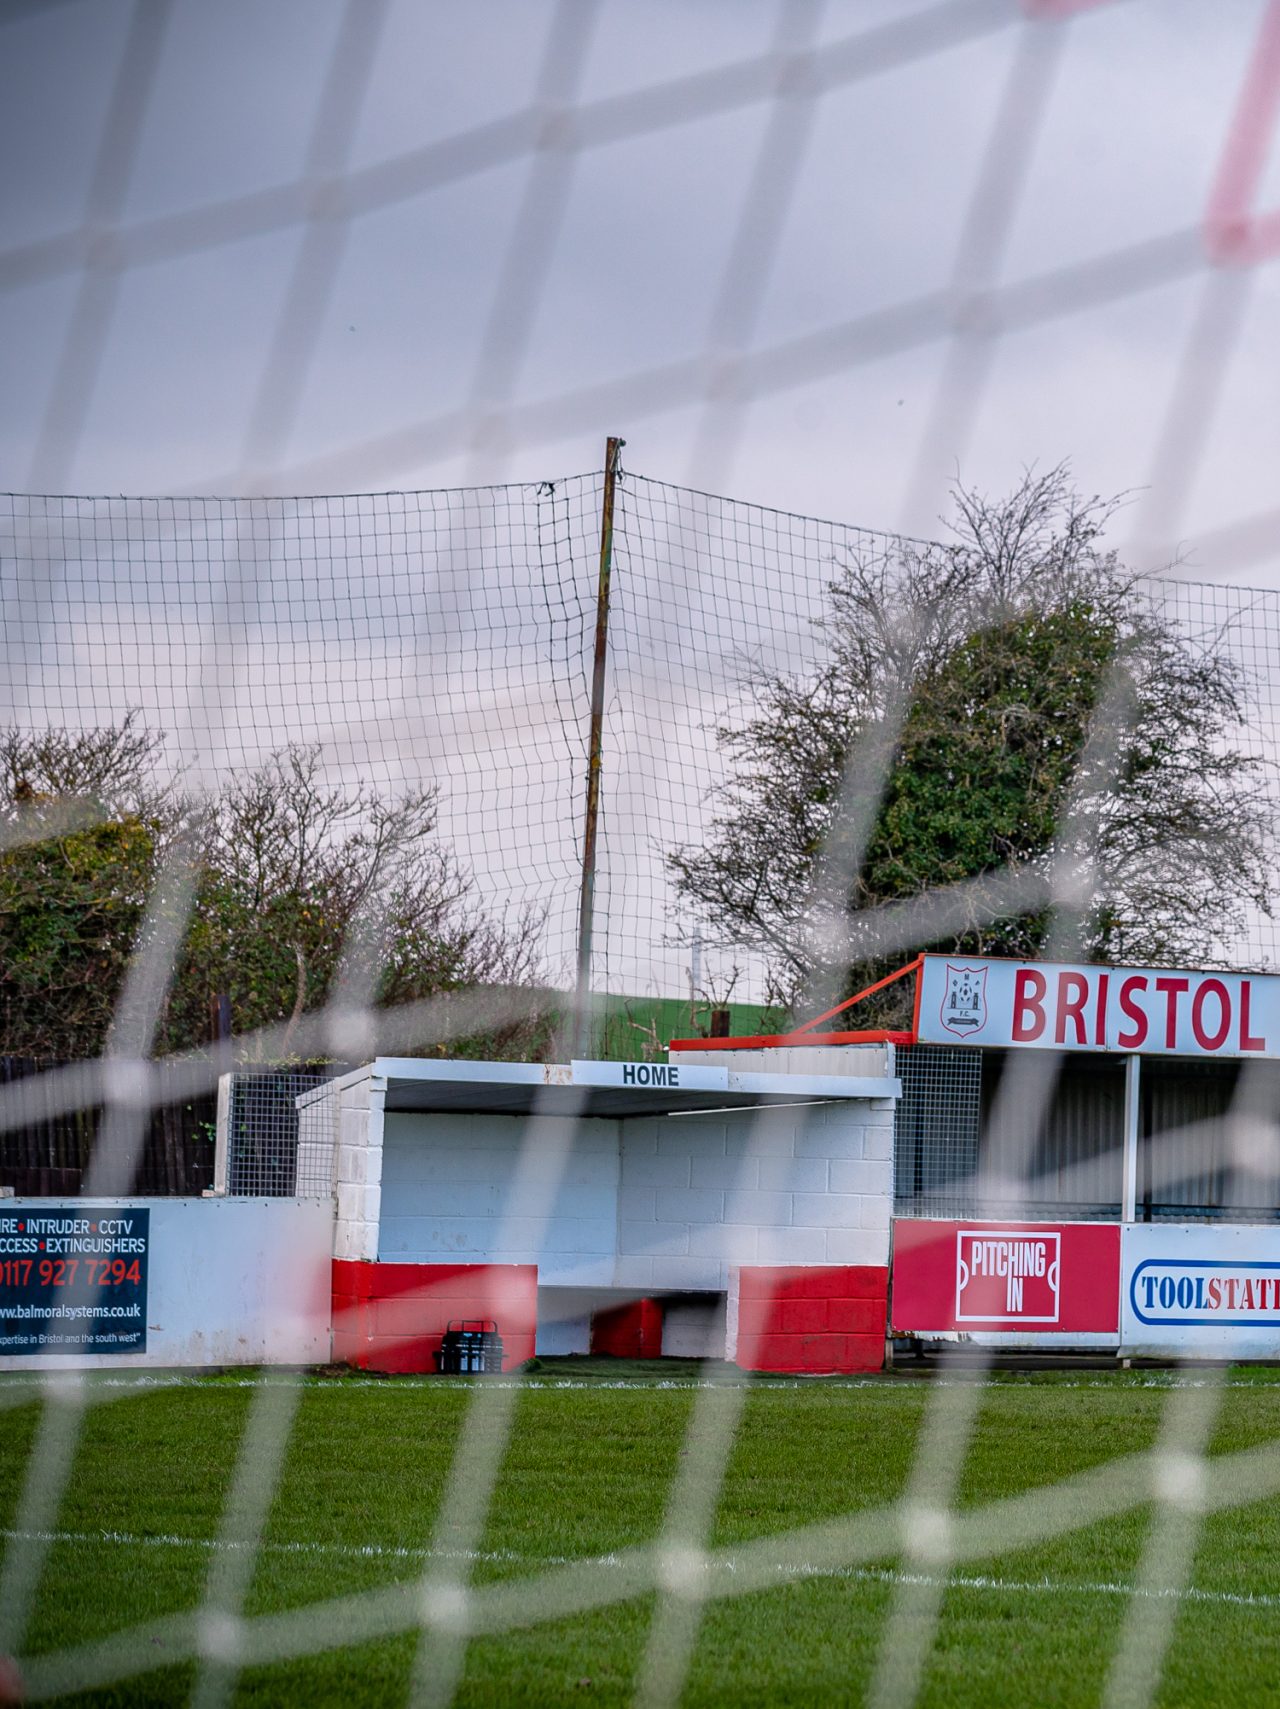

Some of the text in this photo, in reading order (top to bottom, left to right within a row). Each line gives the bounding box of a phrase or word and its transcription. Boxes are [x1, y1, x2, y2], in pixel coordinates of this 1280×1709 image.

[1011, 968, 1266, 1051] BRISTOL
[622, 1064, 680, 1087] HOME
[26, 1219, 91, 1234] INTRUDER
[99, 1219, 133, 1235] CCTV
[45, 1237, 146, 1254] EXTINGUISHERS
[971, 1241, 1046, 1277] PITCHING
[38, 1259, 80, 1287] 927
[84, 1259, 141, 1287] 7294
[1006, 1276, 1023, 1312] IN
[29, 1333, 38, 1344] in
[81, 1333, 93, 1343] the
[94, 1332, 118, 1343] south
